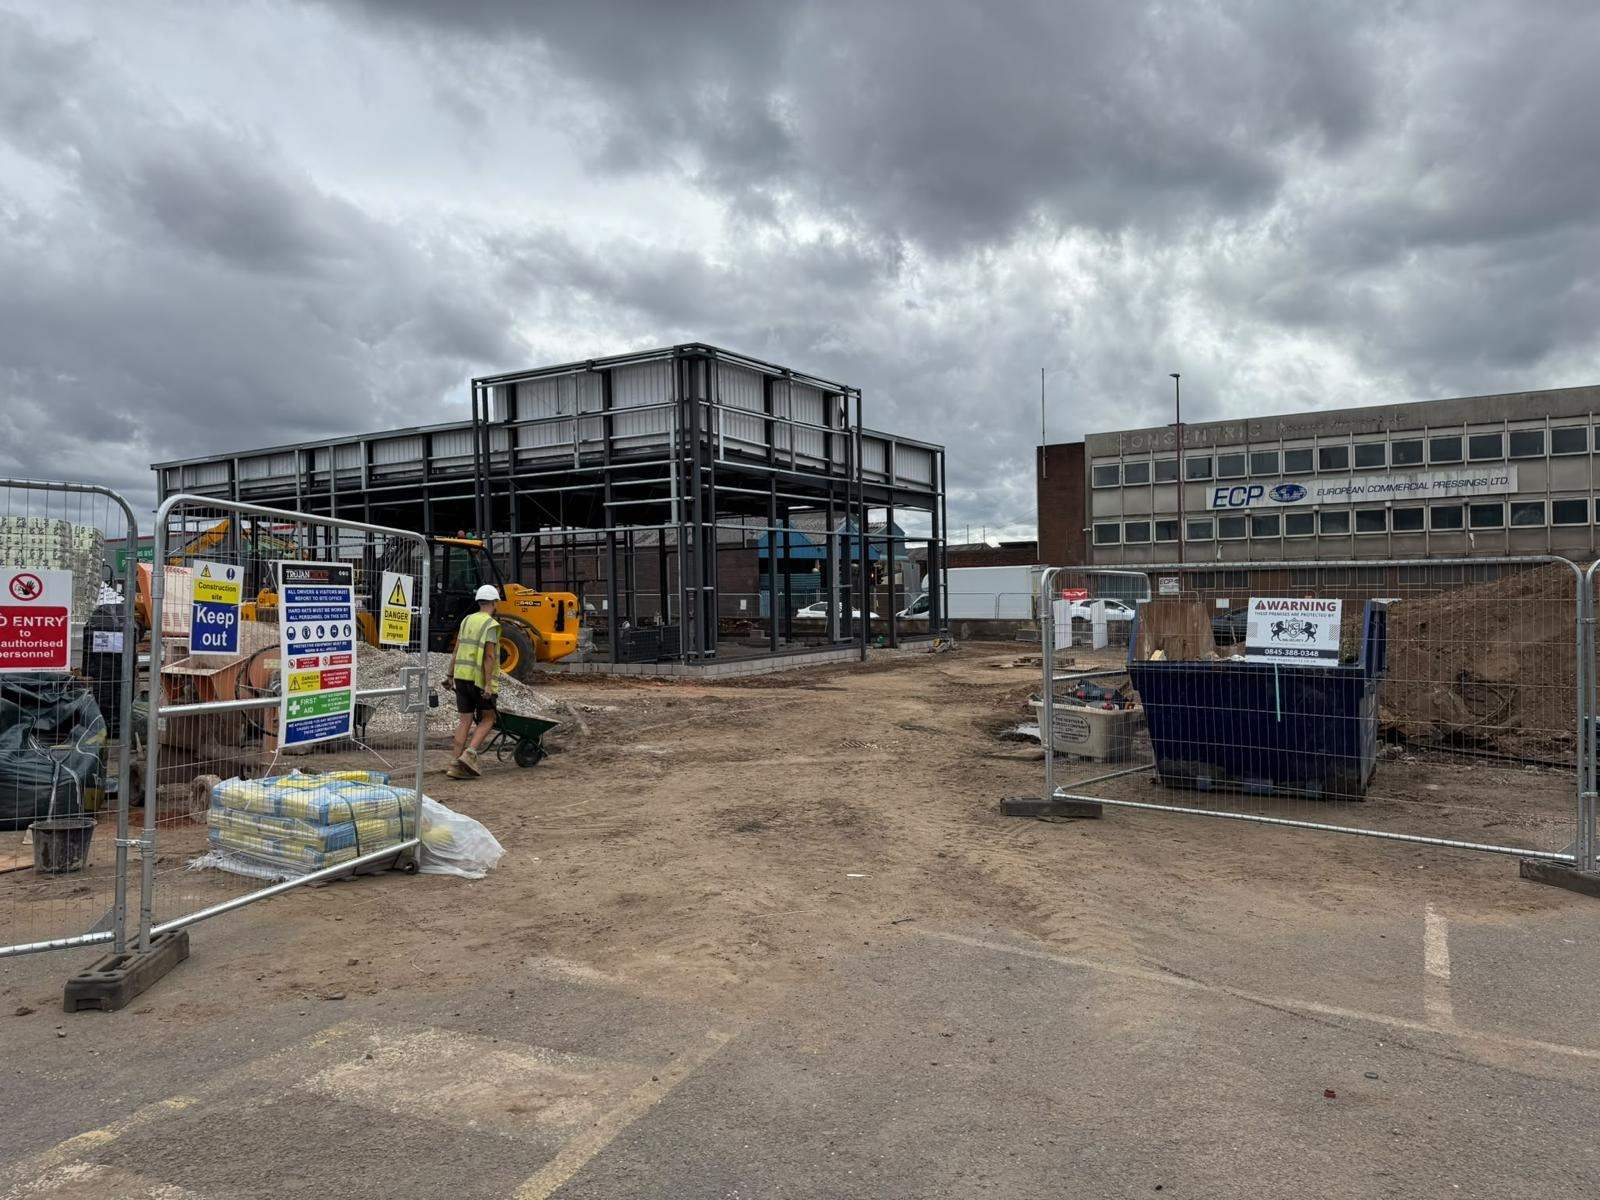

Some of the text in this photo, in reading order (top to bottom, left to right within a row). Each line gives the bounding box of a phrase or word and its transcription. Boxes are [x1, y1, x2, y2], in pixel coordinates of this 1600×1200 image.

[1316, 476, 1510, 496] EUROPEAN COMMERCIAL PRESSINGS LTD.
[1213, 485, 1264, 508] ECP
[286, 570, 310, 578] TROJAN
[198, 582, 236, 592] Construction
[1267, 601, 1336, 612] WARNING
[196, 605, 234, 628] Keep
[385, 610, 408, 620] DANGER
[13, 616, 63, 627] ENTRY
[20, 629, 31, 637] to
[1, 639, 64, 648] authorised
[202, 631, 228, 647] out
[300, 697, 317, 705] FIRST
